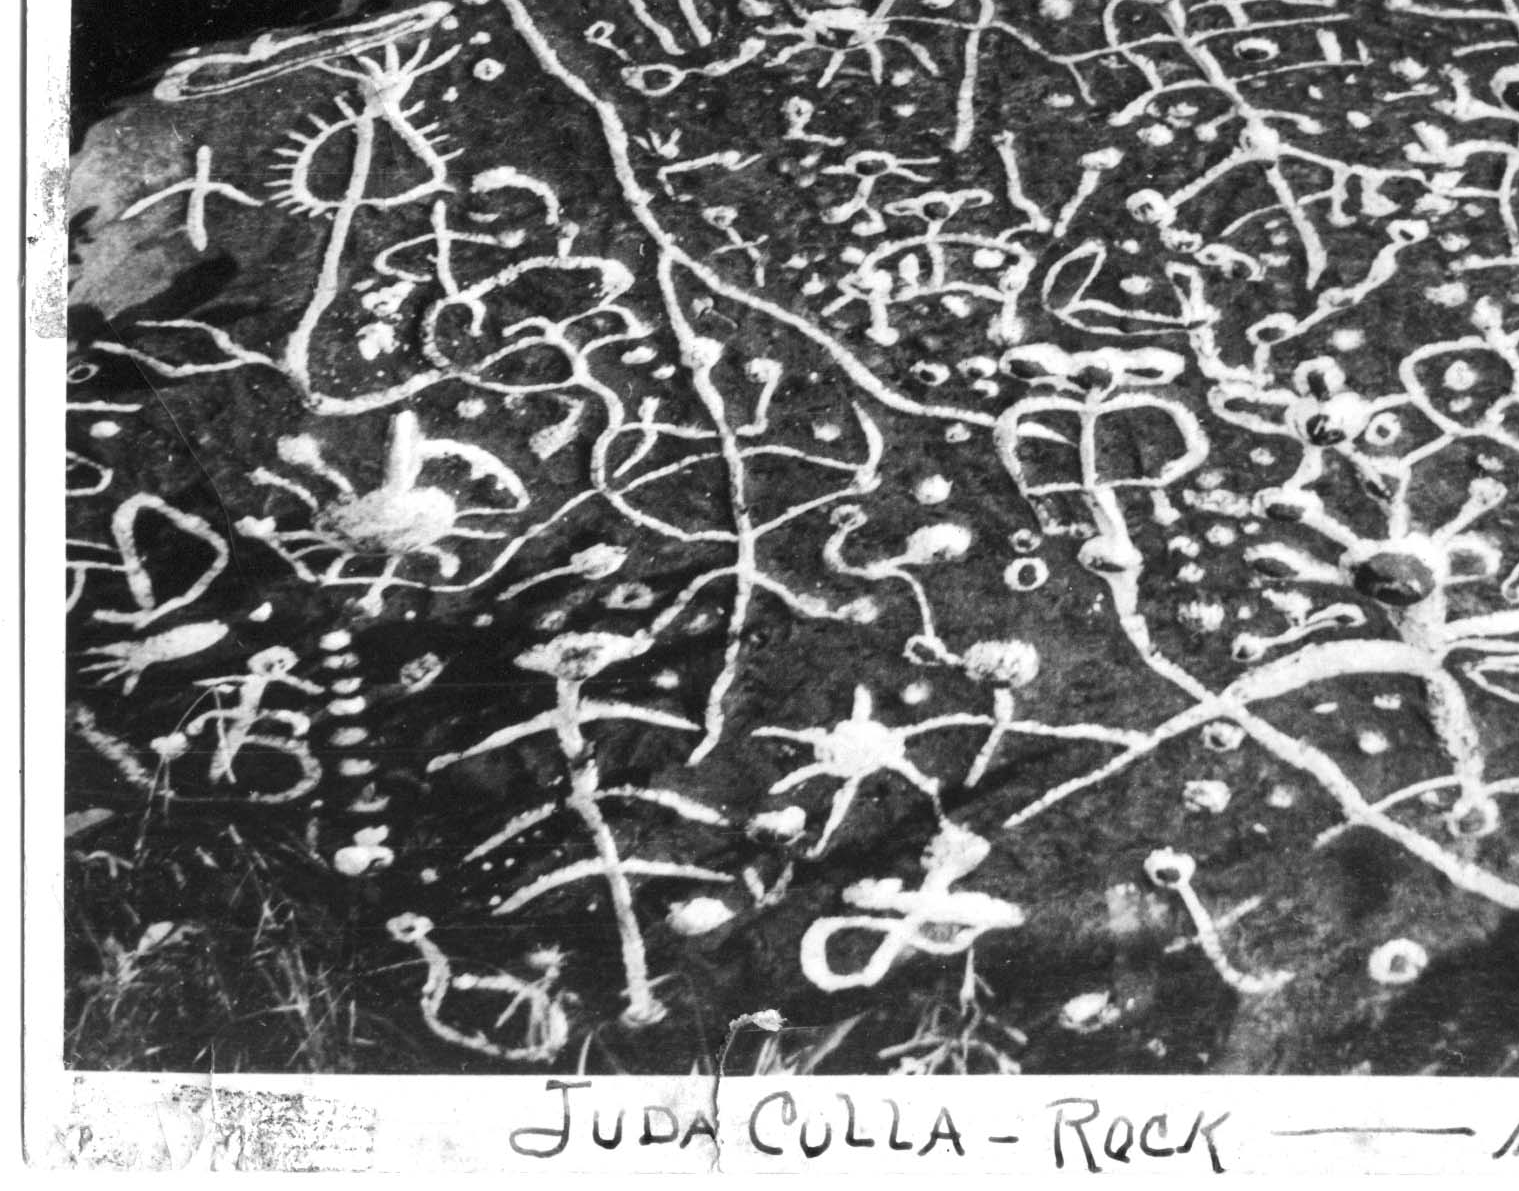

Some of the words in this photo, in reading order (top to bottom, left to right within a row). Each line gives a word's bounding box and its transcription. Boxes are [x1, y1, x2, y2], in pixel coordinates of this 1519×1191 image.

[510, 1079, 715, 1158] JUDA
[749, 1090, 966, 1158] CULLA
[1046, 1096, 1231, 1174] ROCK
